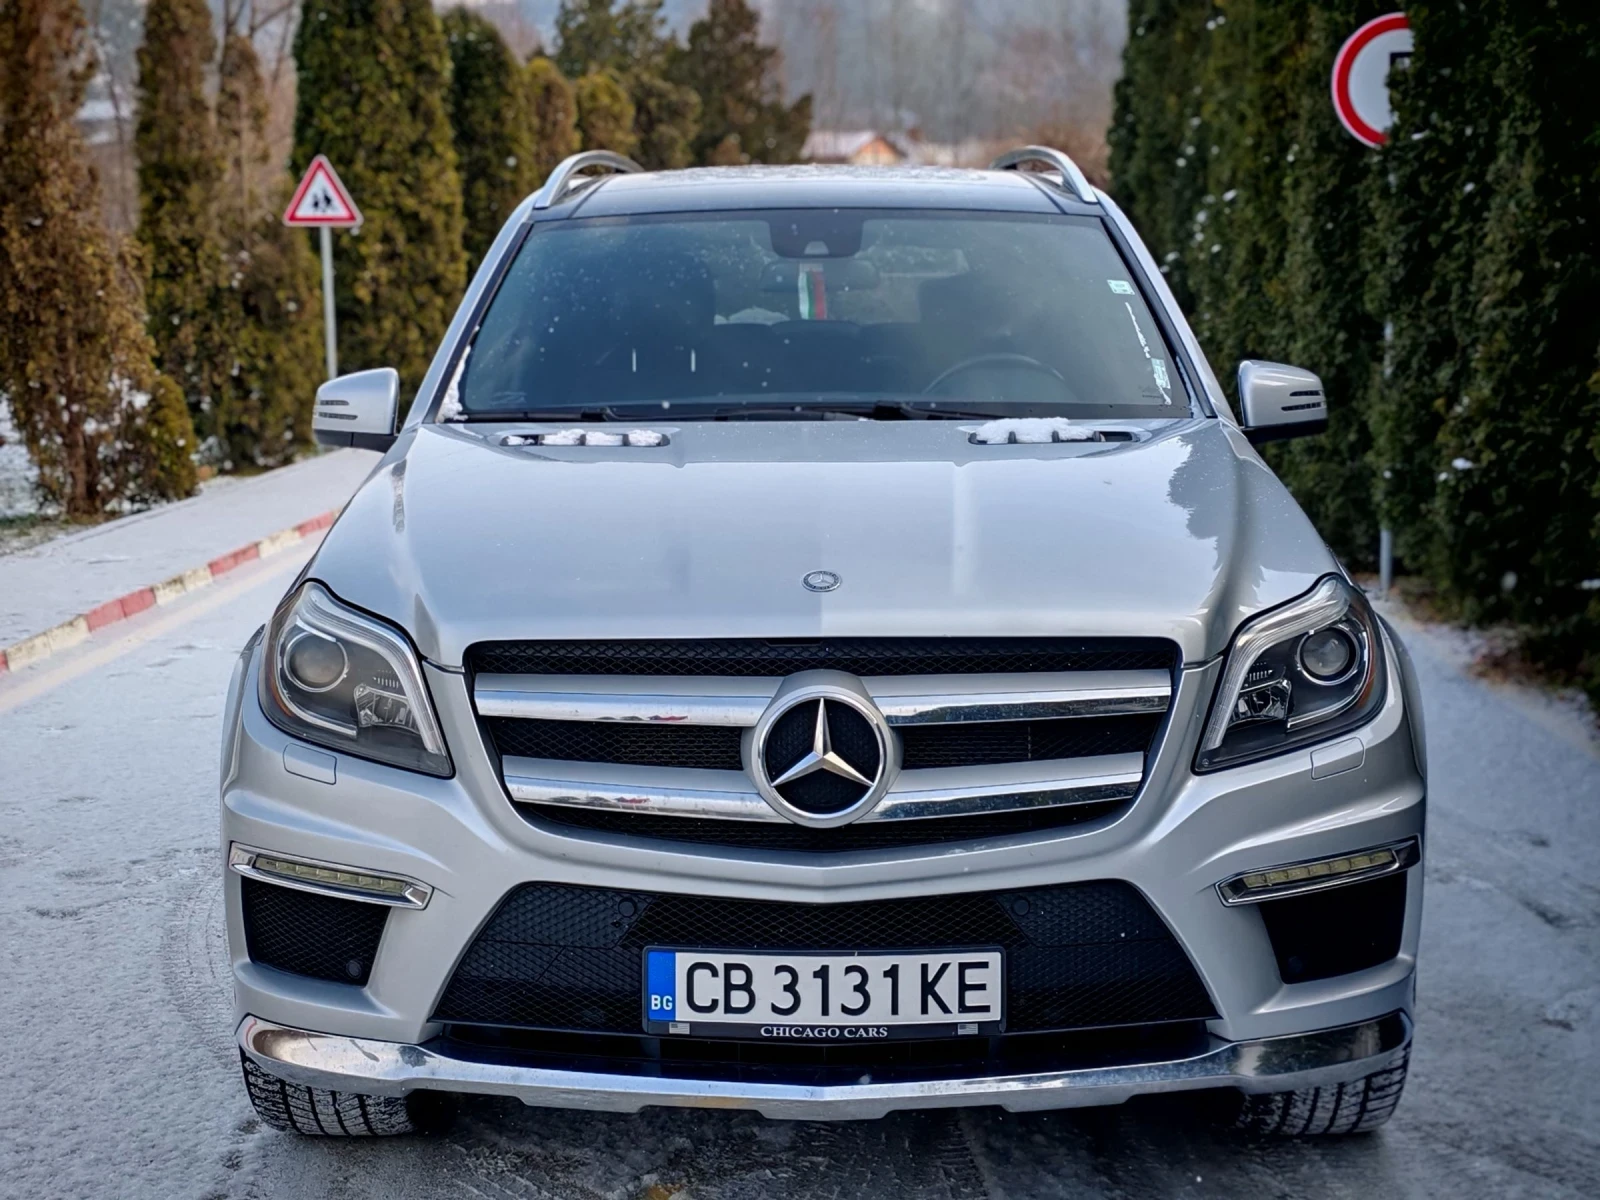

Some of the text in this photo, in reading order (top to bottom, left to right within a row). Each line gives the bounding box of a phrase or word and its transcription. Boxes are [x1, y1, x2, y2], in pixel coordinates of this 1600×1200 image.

[686, 961, 991, 1017] CB 3131 KE
[651, 995, 673, 1011] BG
[760, 1026, 888, 1039] CHICAGO CARS
